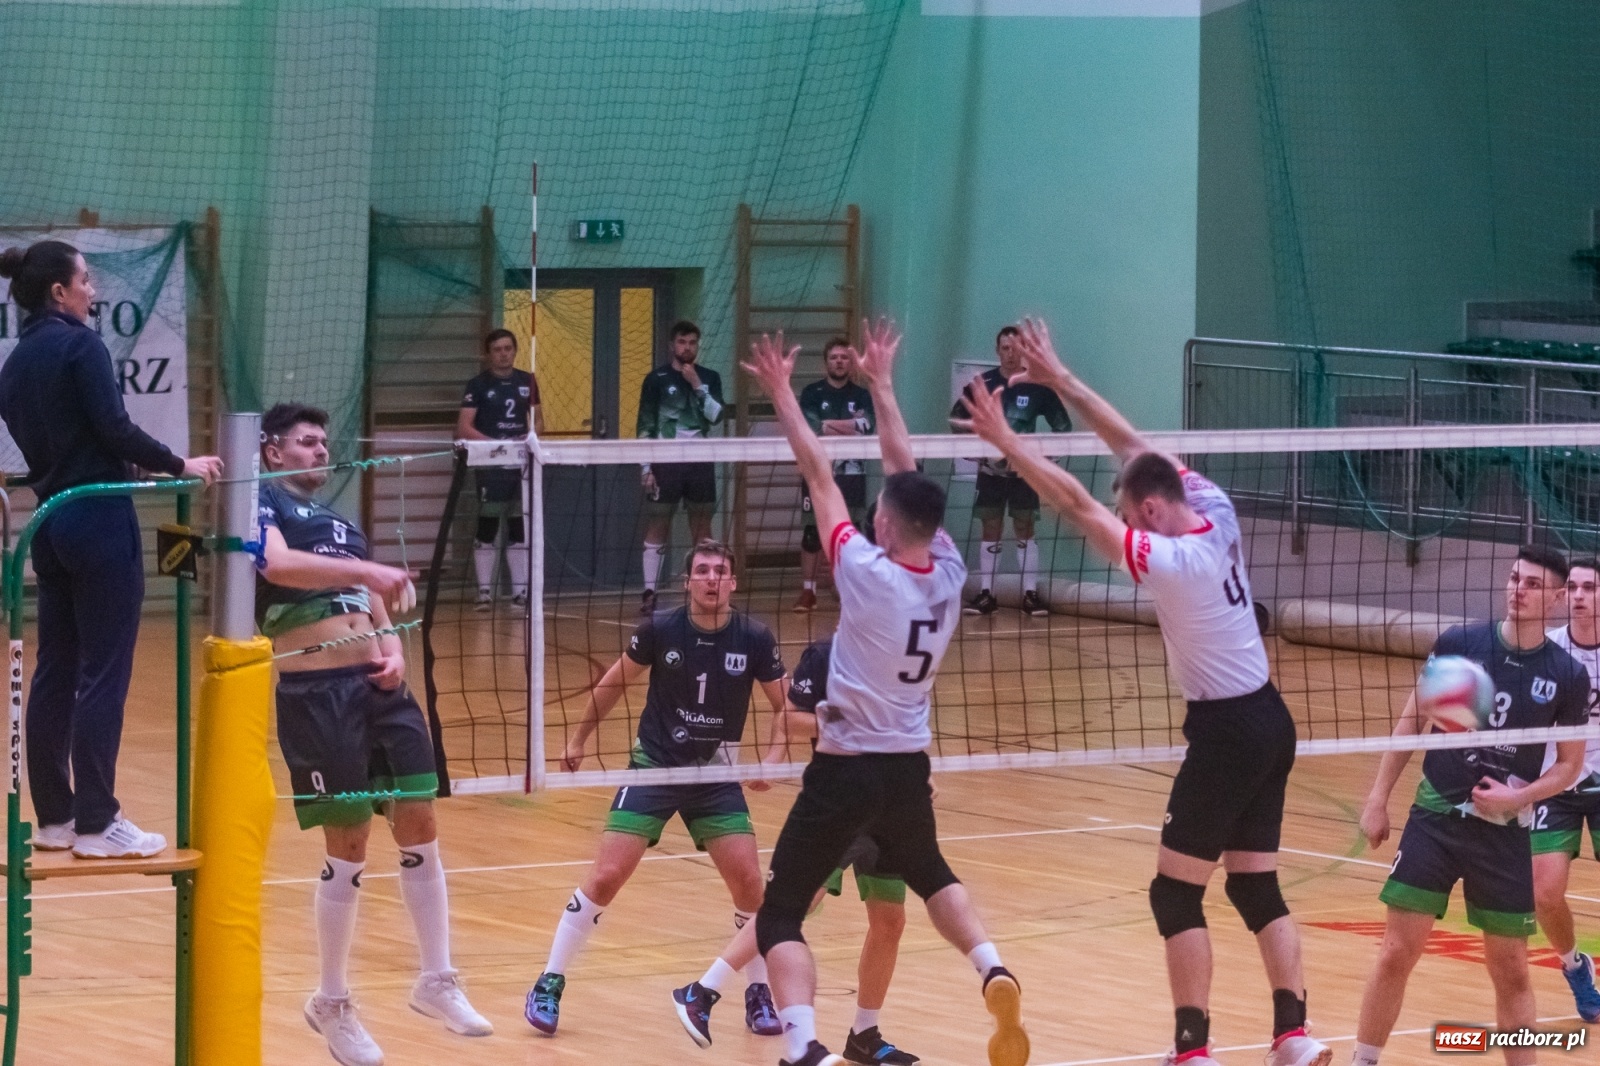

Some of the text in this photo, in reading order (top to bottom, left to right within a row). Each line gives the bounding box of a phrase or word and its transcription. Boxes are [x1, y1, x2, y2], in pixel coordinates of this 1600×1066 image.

[505, 398, 516, 418] 2
[1223, 563, 1248, 609] 4
[898, 619, 939, 684] 5
[696, 672, 708, 704] 1
[1488, 691, 1513, 728] 3
[617, 785, 629, 809] 1
